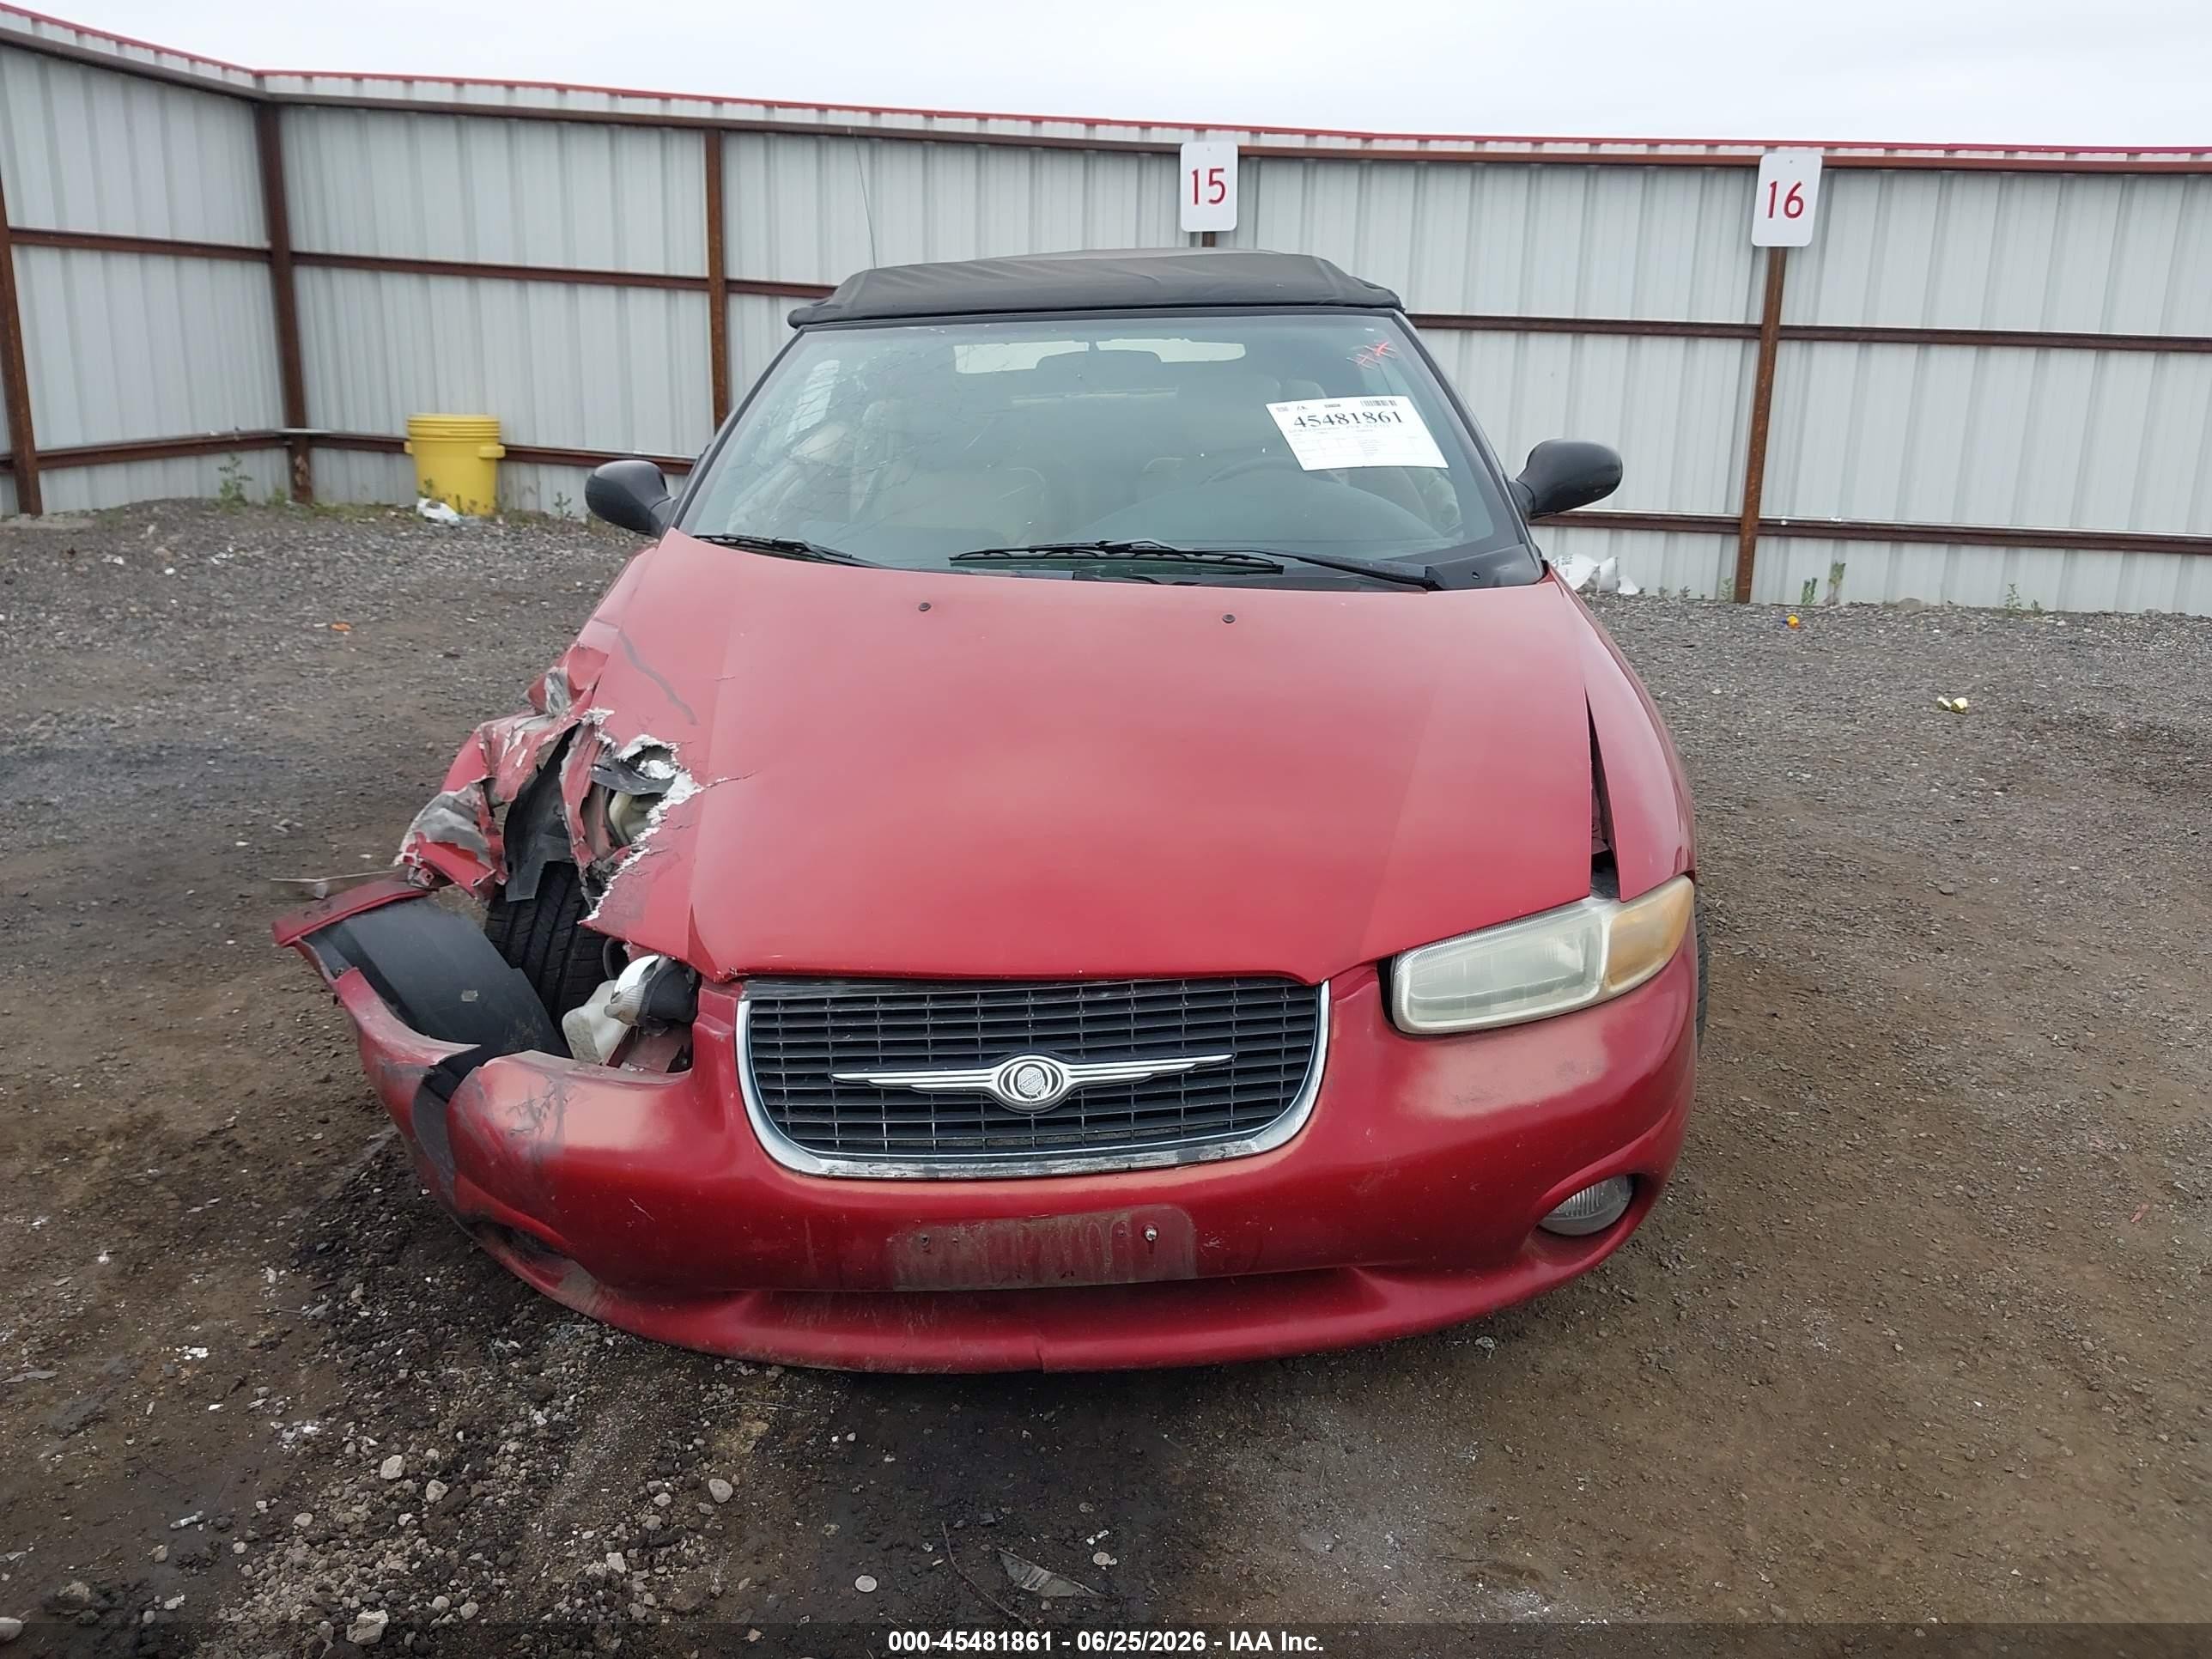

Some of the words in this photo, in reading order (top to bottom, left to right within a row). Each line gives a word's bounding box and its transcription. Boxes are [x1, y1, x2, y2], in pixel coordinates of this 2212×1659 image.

[1192, 167, 1226, 205] 15
[1767, 180, 1804, 219] 16
[1293, 410, 1404, 428] 45481861
